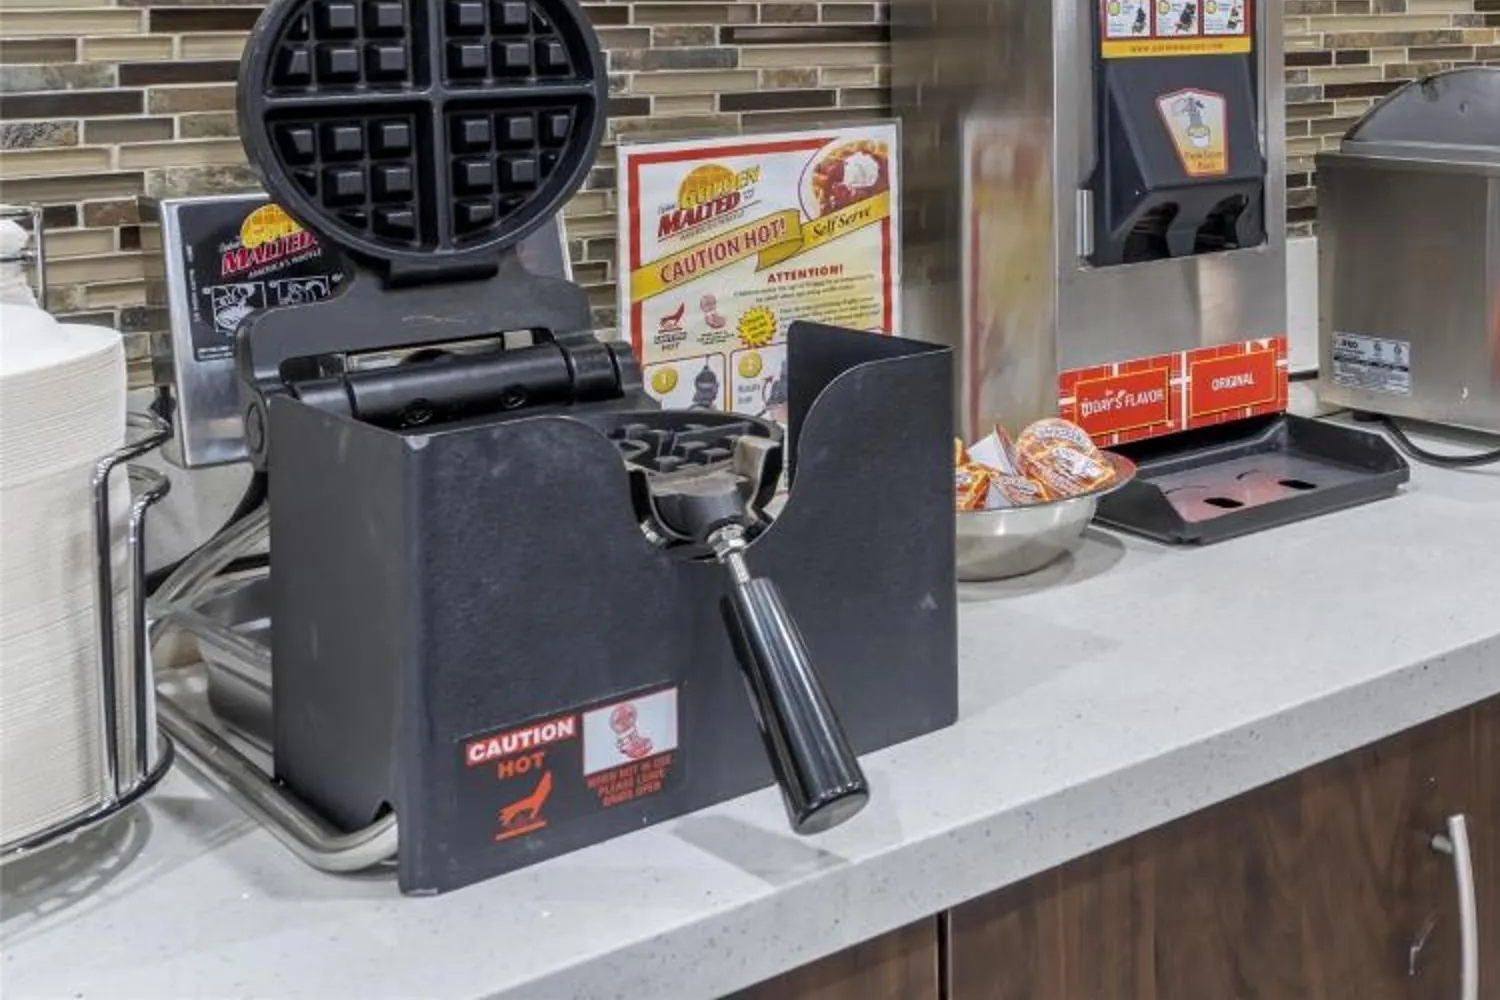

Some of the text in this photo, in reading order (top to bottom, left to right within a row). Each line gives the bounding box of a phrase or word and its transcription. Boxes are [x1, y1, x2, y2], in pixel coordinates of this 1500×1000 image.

[657, 190, 741, 238] MALTED
[811, 205, 872, 239] Self Serve
[221, 231, 320, 279] MALTED
[660, 217, 786, 283] CAUTION HOT!
[767, 263, 844, 284] ATTENTION!
[1124, 389, 1165, 408] FLAVOR
[1211, 372, 1256, 391] ORIGINAL
[467, 717, 577, 762] CAUTION
[497, 751, 546, 779] HOT
